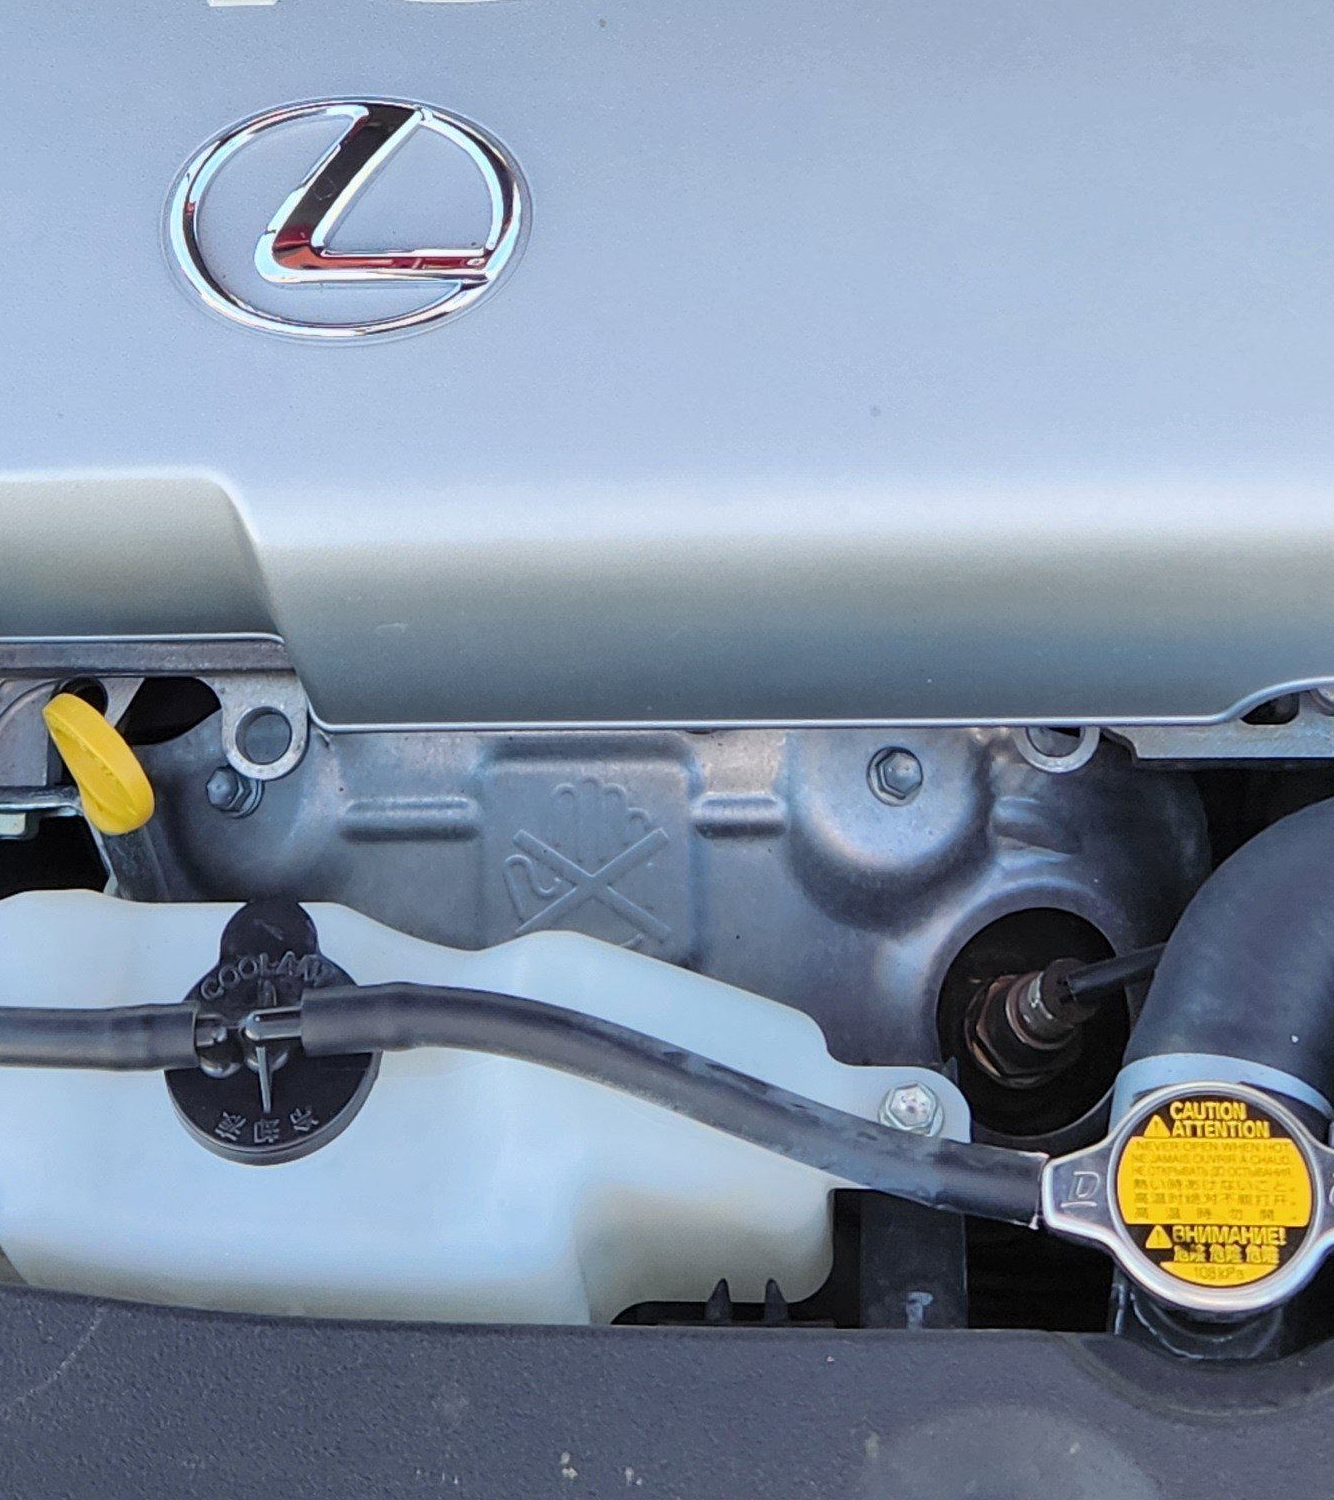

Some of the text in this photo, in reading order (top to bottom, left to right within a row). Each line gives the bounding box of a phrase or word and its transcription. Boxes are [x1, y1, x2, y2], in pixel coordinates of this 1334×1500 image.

[1170, 1101, 1246, 1120] CAUTION
[1172, 1121, 1270, 1138] ATTENTION
[1136, 1141, 1290, 1153] NEVER OPEN WHEN HOT
[1172, 1225, 1287, 1245] ВНИМАНИЕ!
